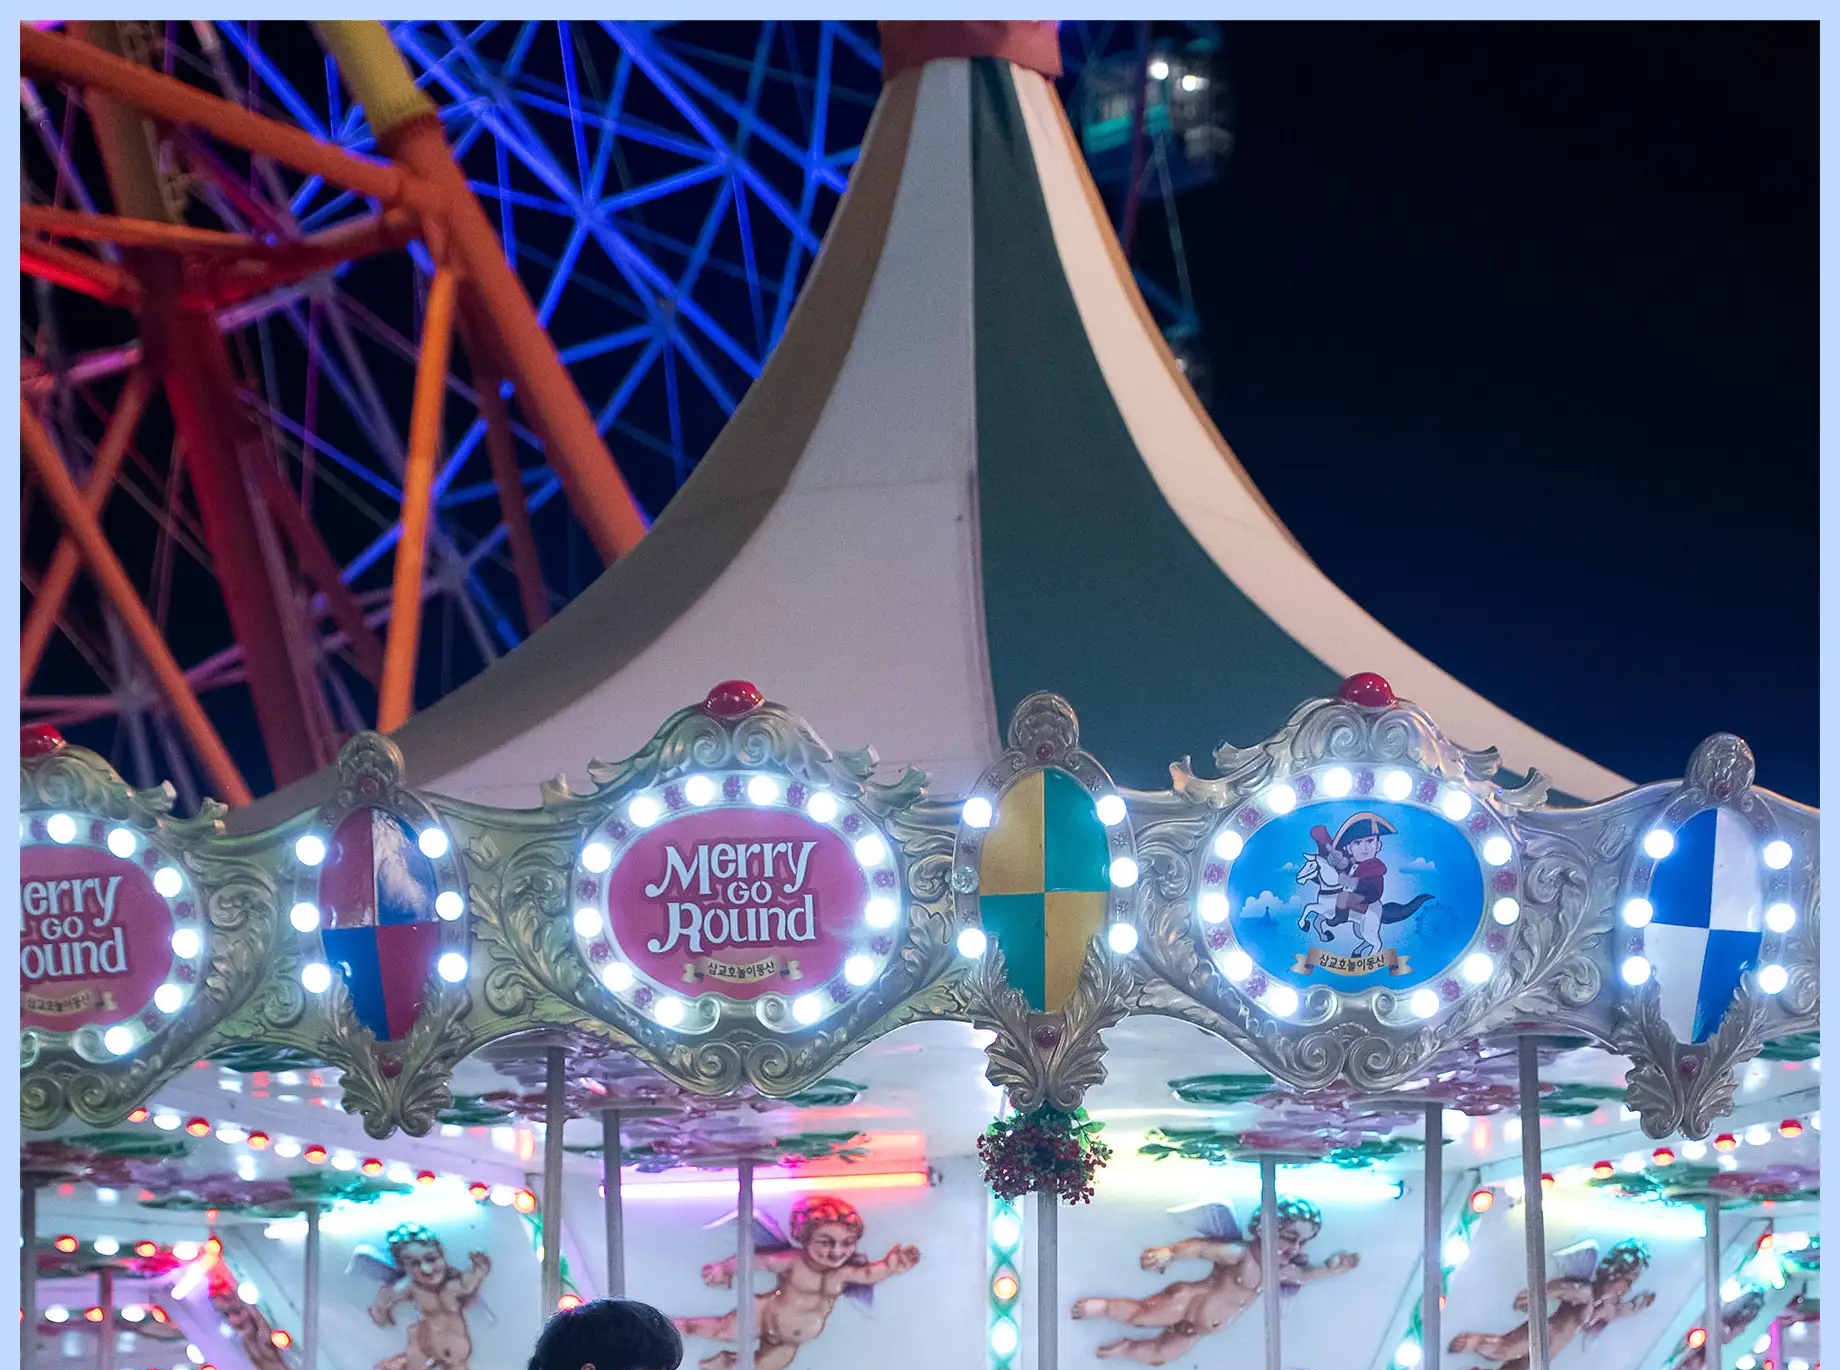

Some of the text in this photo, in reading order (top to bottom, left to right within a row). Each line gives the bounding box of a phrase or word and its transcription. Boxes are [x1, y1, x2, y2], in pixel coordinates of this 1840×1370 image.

[645, 841, 818, 898] Merry
[20, 875, 122, 932] erry
[727, 881, 772, 905] GO
[40, 916, 84, 940] GO
[647, 894, 816, 953] Round
[707, 960, 775, 979] 삽교호놀이동산
[1319, 954, 1385, 972] 삽교호놀이동산
